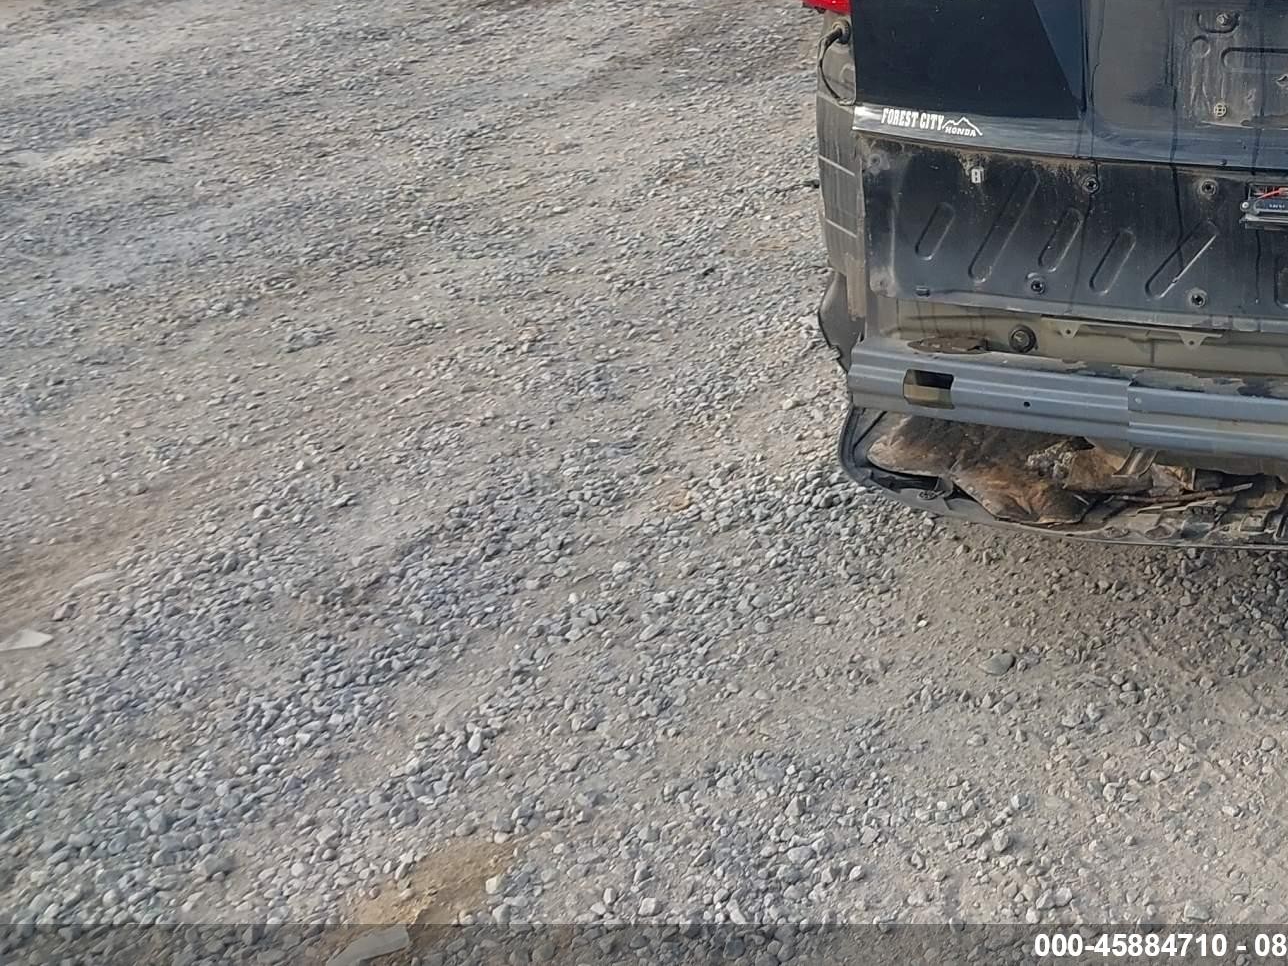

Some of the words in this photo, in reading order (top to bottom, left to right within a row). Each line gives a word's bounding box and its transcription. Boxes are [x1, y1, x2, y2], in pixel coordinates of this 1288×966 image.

[881, 107, 920, 128] FOREST
[919, 112, 945, 131] CITY
[944, 126, 977, 137] HONDA
